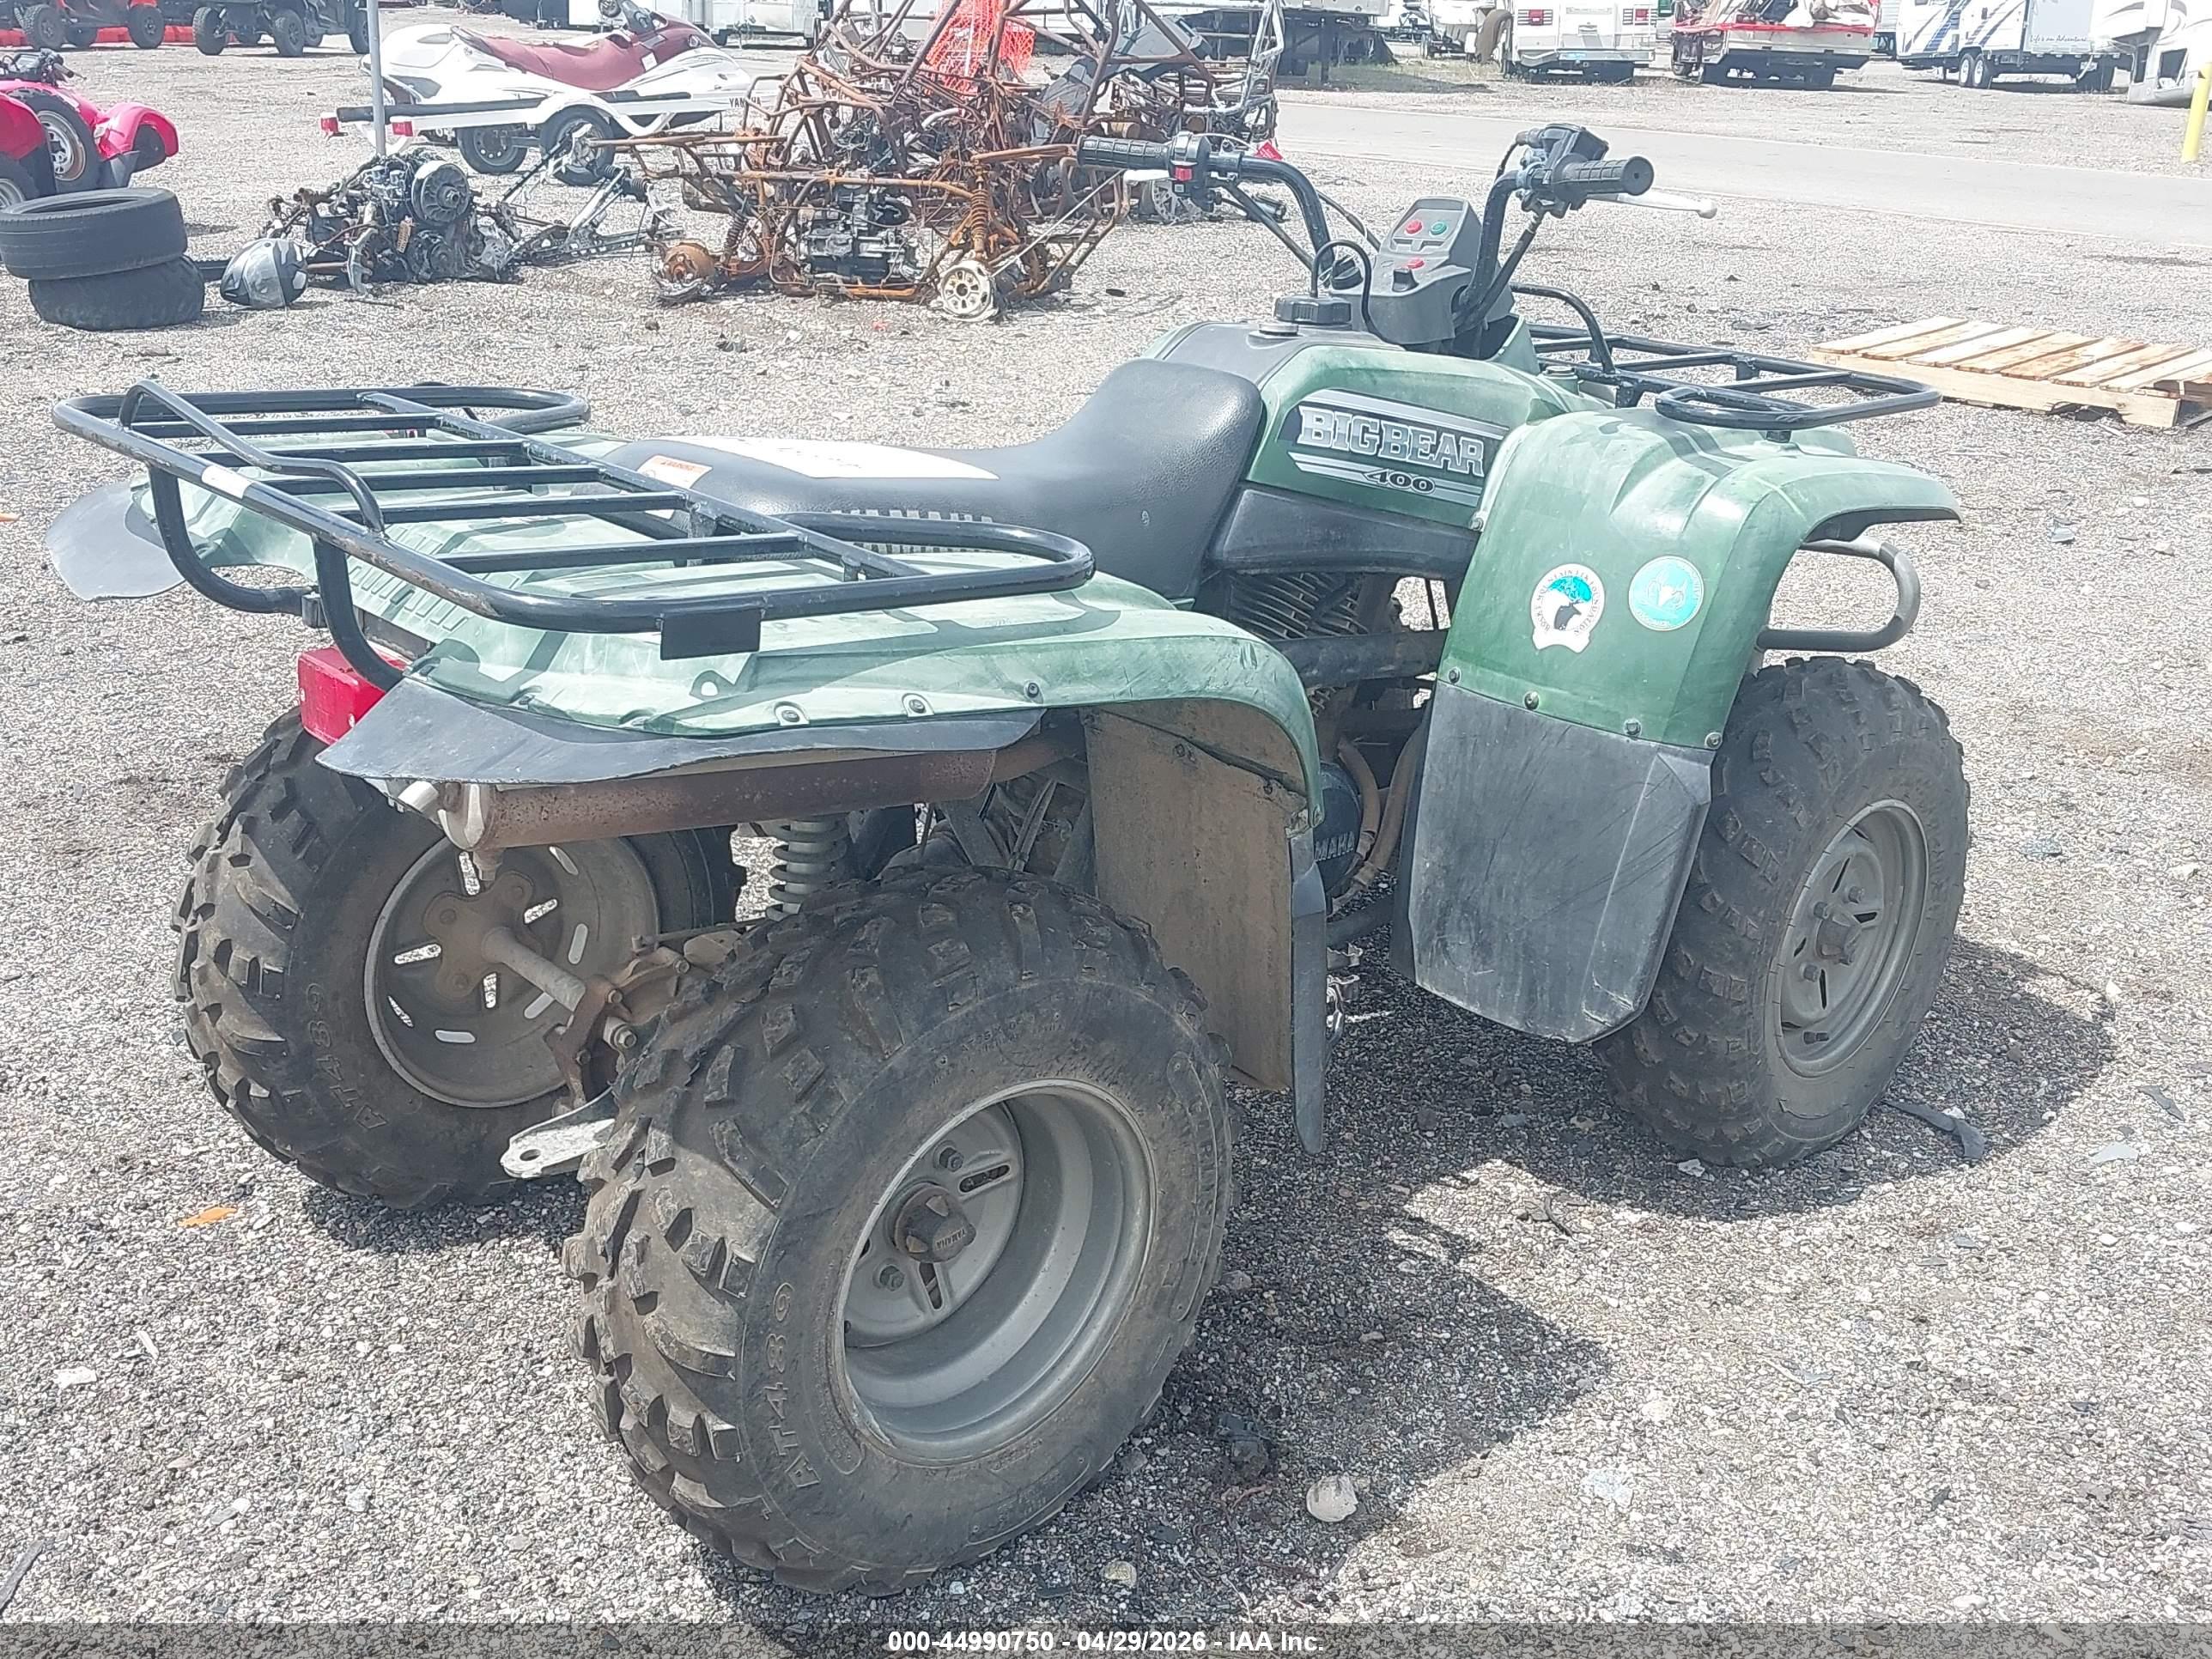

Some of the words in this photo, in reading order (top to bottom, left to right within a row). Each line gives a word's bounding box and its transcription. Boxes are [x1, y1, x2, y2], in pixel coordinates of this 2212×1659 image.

[729, 96, 762, 108] YAMHA
[1364, 468, 1435, 494] 400
[763, 1282, 821, 1489] AT489
